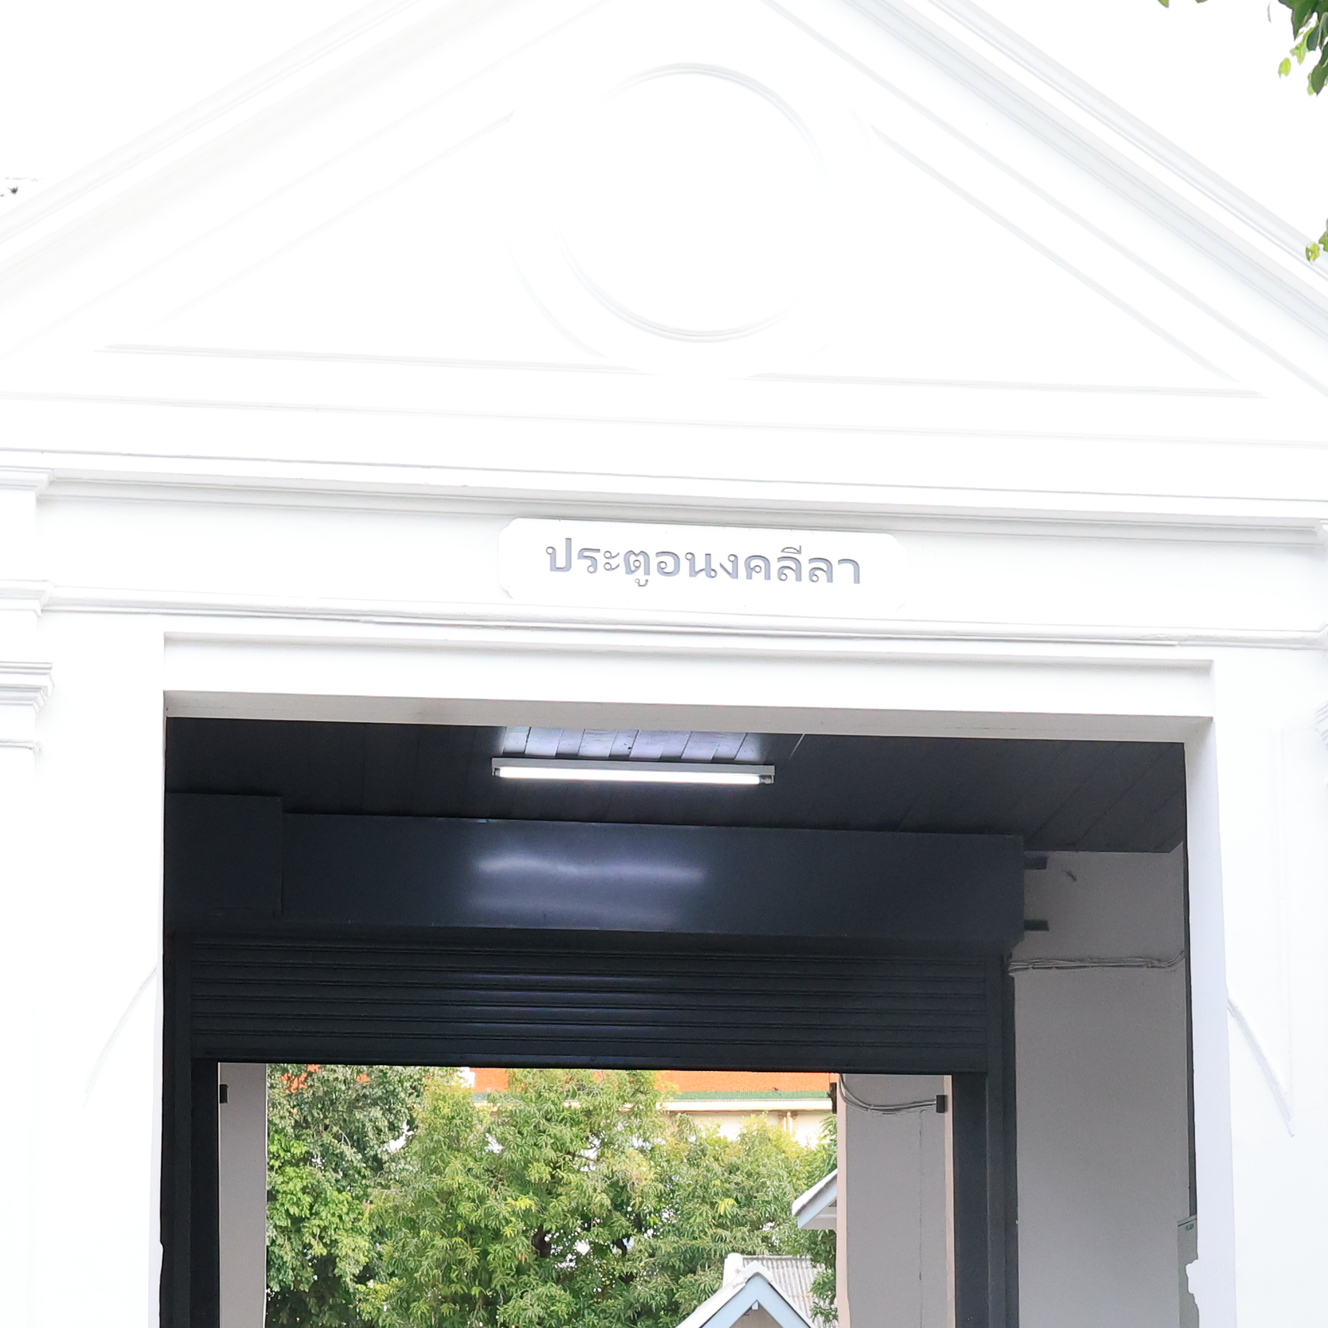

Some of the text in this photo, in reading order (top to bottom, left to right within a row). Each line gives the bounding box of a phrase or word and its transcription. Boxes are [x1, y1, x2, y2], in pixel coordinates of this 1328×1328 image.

[544, 536, 862, 588] ประตูอนงคลีลา
